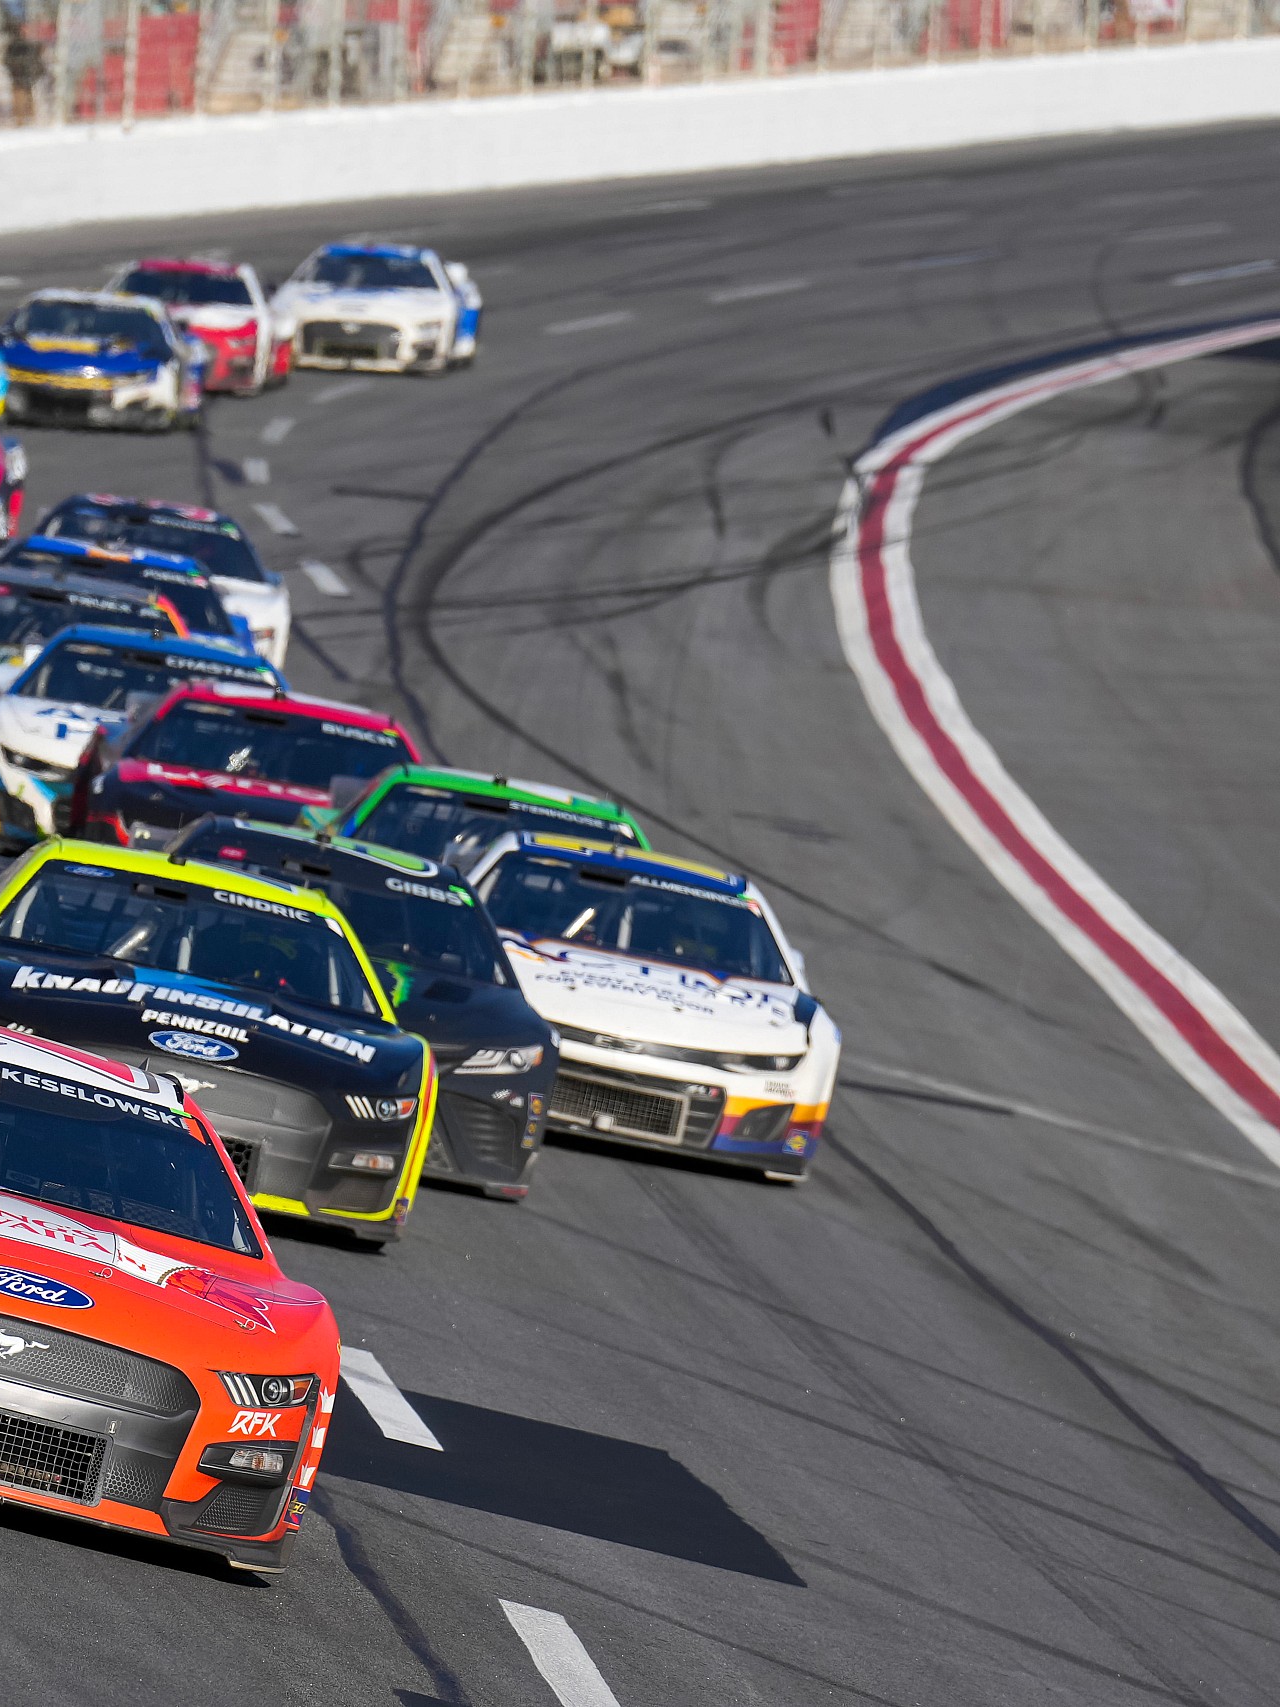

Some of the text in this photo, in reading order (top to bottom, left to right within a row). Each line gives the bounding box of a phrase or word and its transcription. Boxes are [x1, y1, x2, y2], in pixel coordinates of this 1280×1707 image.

[321, 721, 398, 748] BUSCH
[213, 889, 311, 923] CINDRIC
[385, 877, 464, 907] GIBBS
[140, 1008, 250, 1044] PENNZOIL
[163, 1031, 222, 1059] Ford
[1, 1066, 189, 1130] KESELOWSKI
[227, 1410, 282, 1438] RFK
